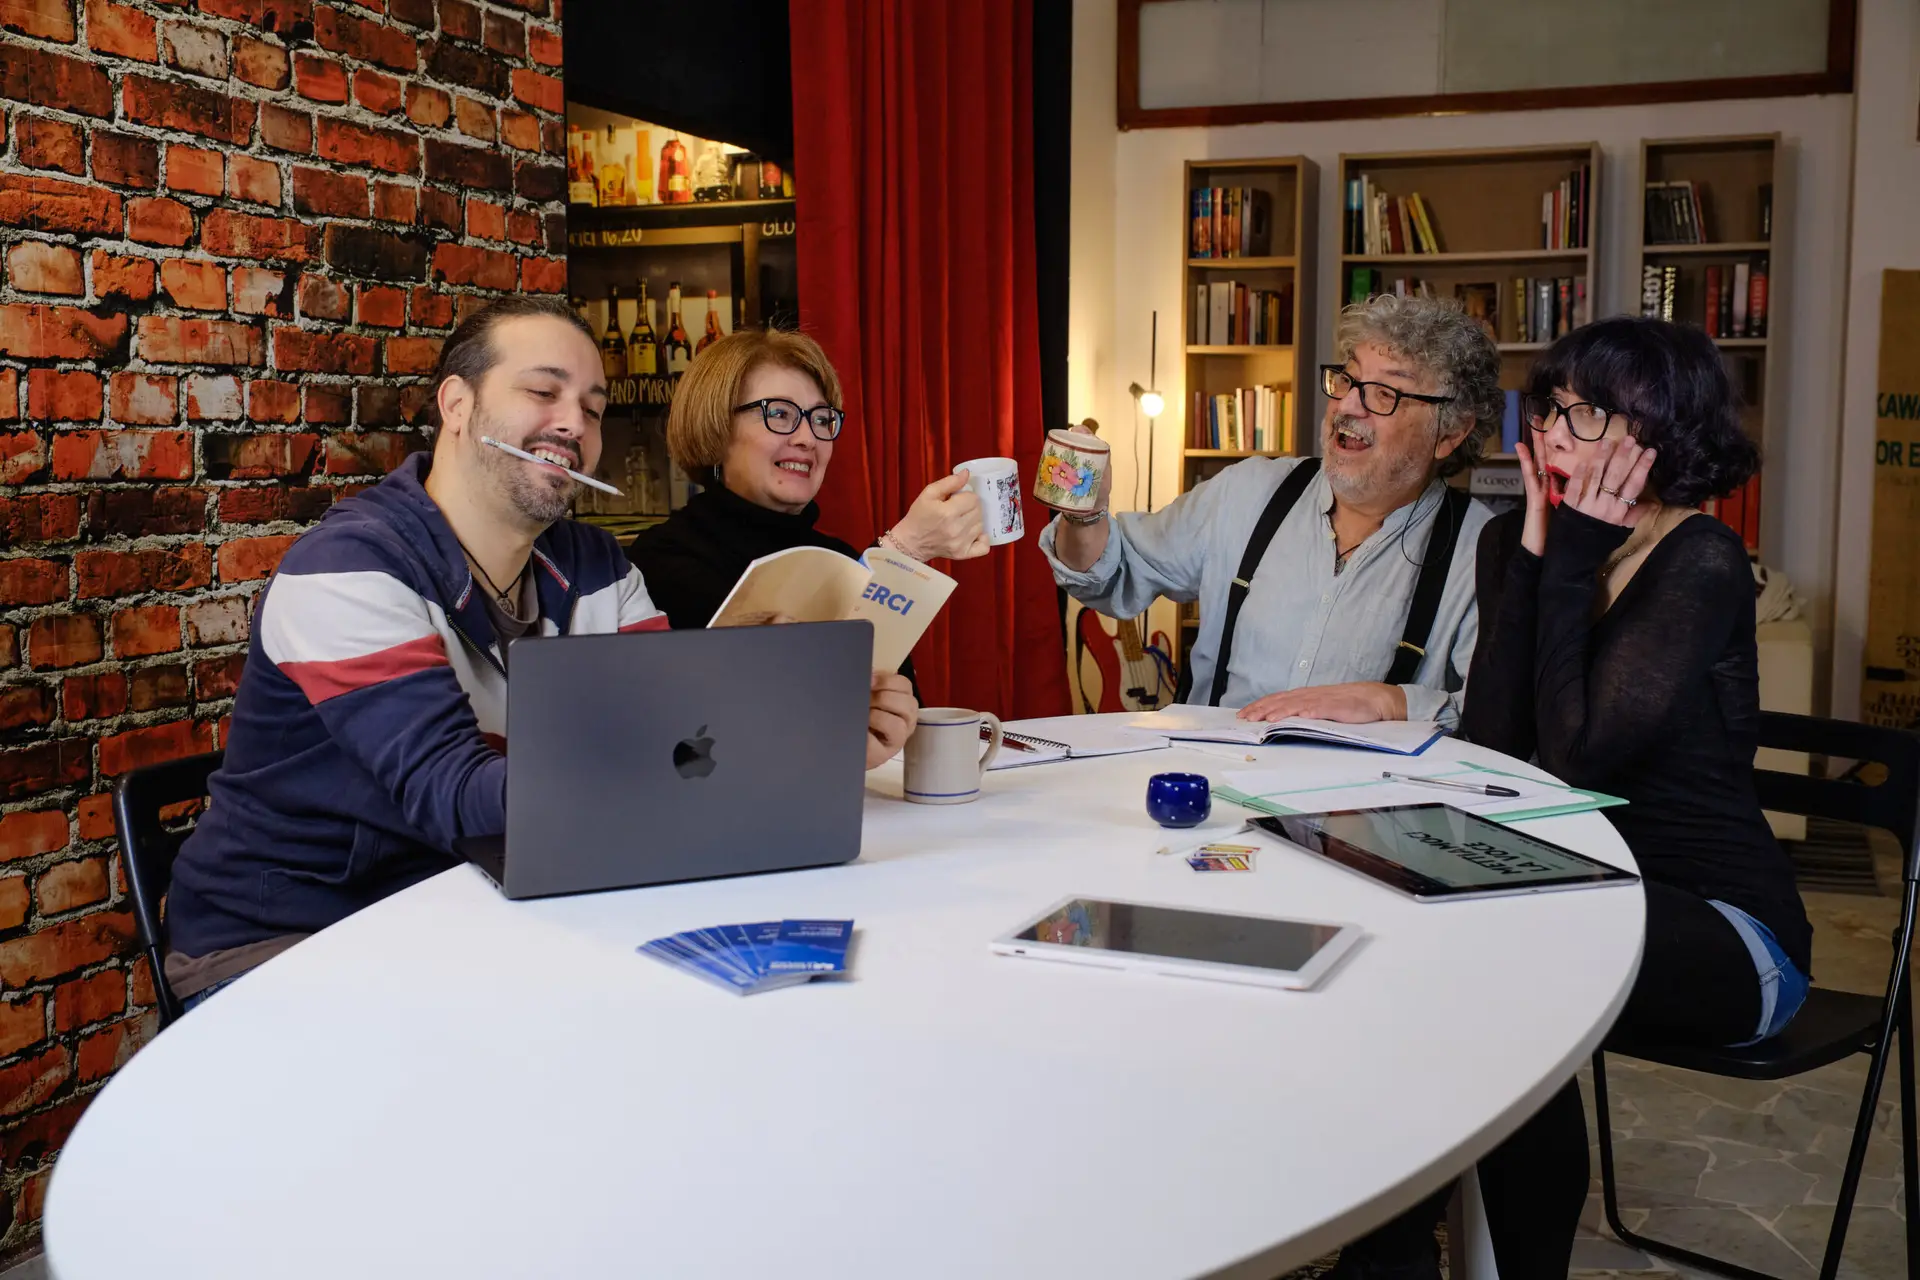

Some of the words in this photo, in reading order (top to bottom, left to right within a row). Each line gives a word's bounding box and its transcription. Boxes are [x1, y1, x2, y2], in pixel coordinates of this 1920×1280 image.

[608, 378, 637, 405] AND
[639, 376, 678, 405] MARN
[1403, 831, 1523, 875] METTIAMOCI
[1463, 842, 1520, 861] VOCE
